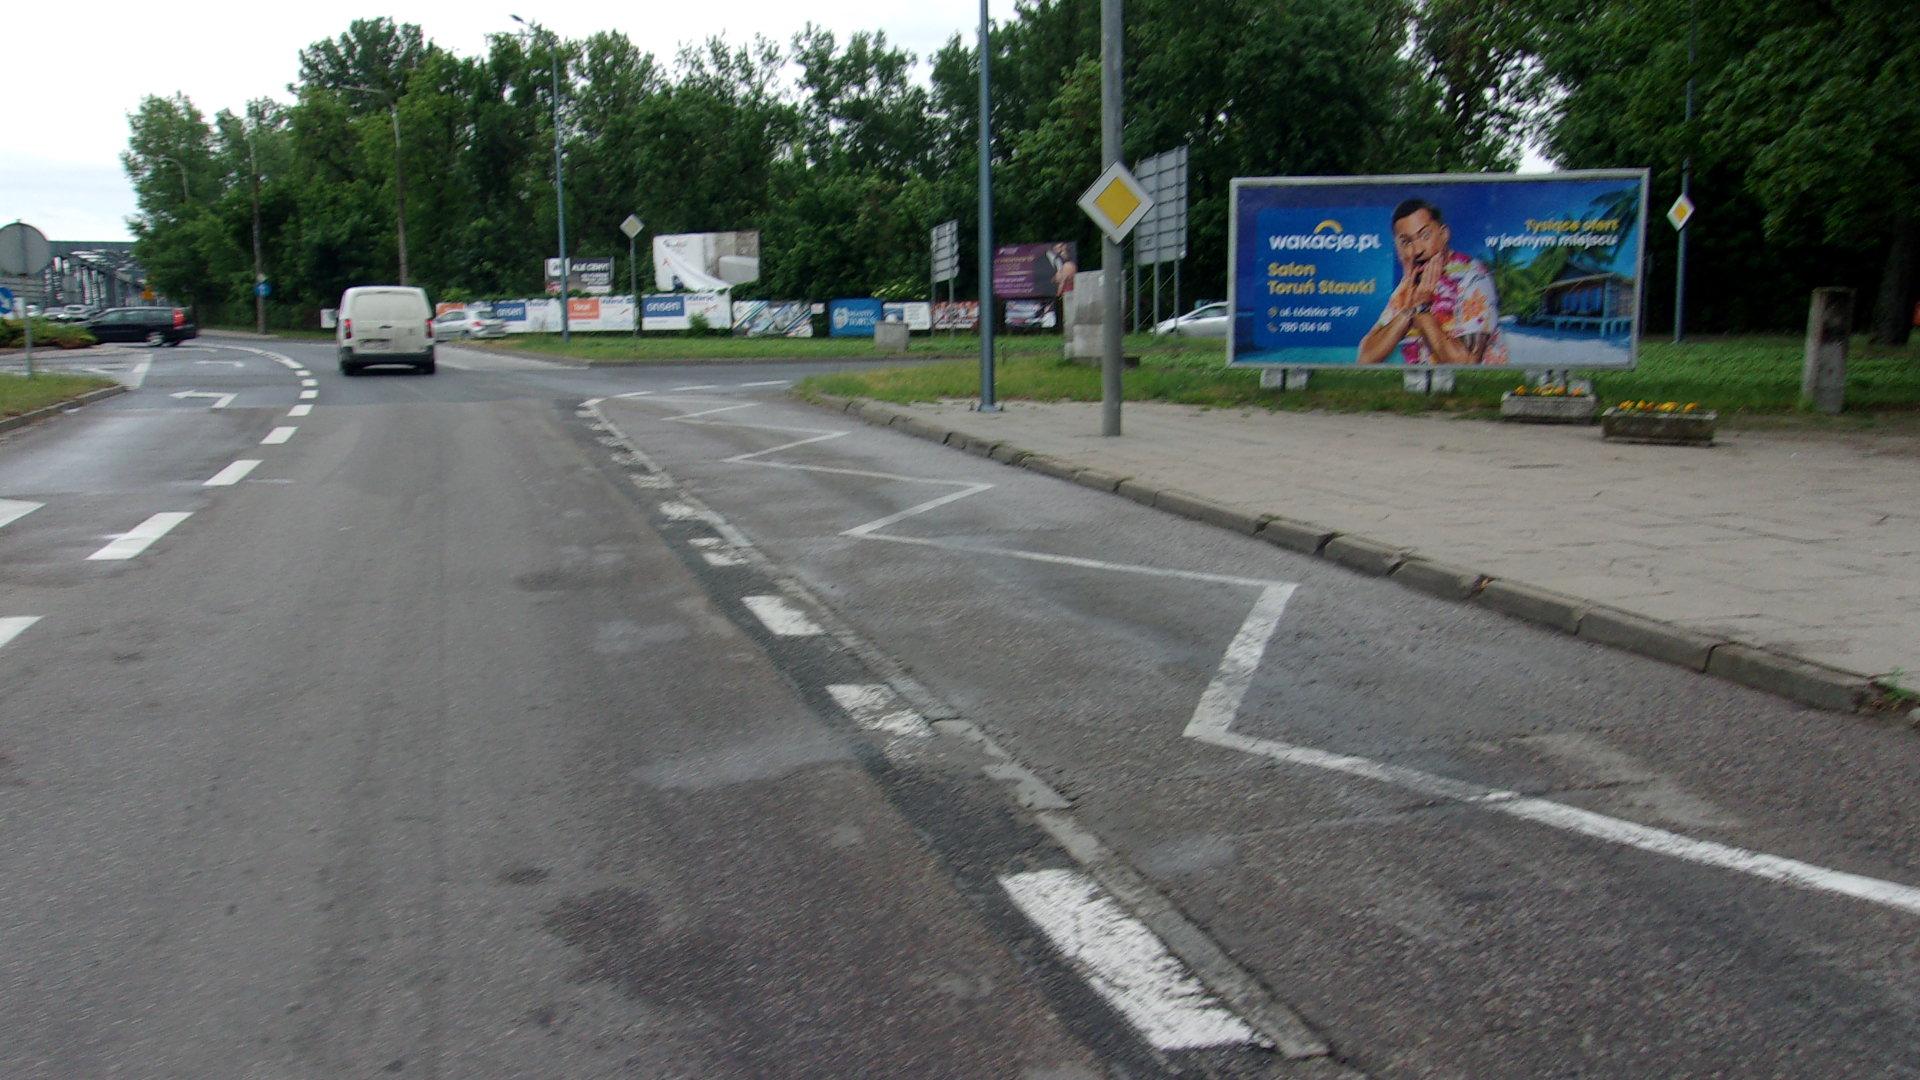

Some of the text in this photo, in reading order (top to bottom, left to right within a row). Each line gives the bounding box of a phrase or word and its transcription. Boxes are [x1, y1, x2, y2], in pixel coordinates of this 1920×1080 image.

[1269, 234, 1381, 253] wakacje.pl
[1268, 263, 1316, 277] Salon
[1267, 279, 1376, 296] Toruń Stawki
